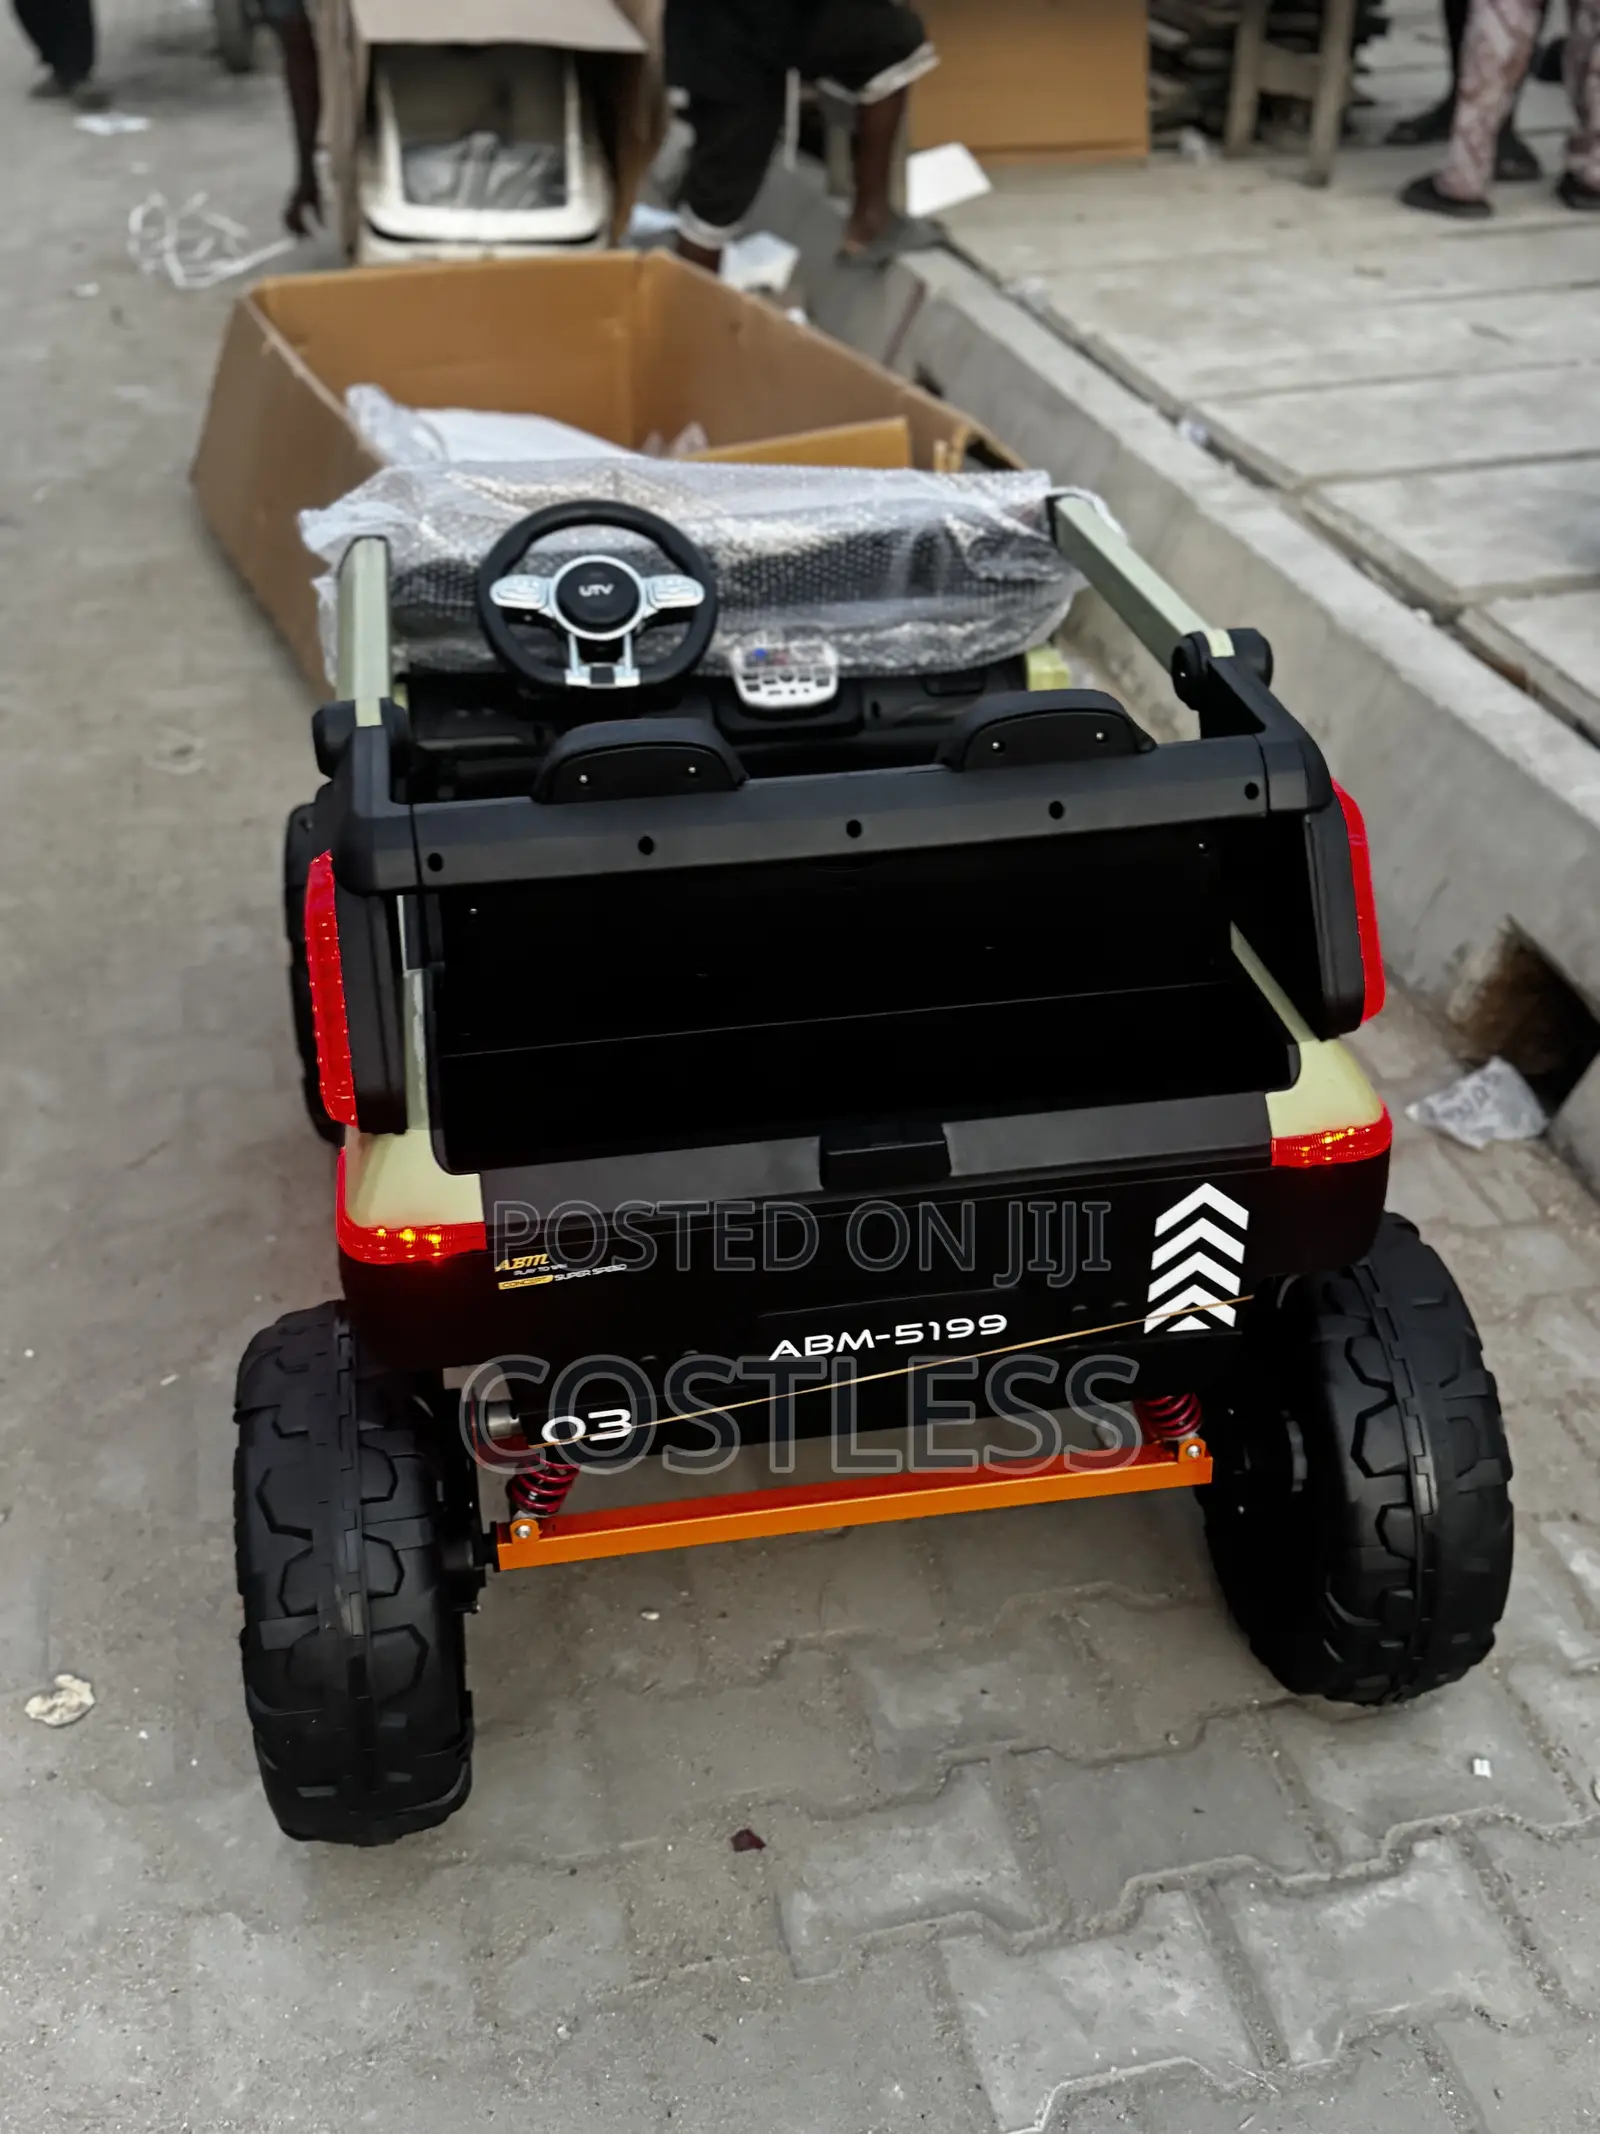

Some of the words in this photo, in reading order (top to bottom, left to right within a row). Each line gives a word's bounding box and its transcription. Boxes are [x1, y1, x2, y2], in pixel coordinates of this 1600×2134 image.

[578, 583, 615, 597] UTV
[554, 1269, 592, 1281] SUPER
[768, 1314, 1008, 1361] ABM-5199
[541, 1408, 633, 1446] 03
